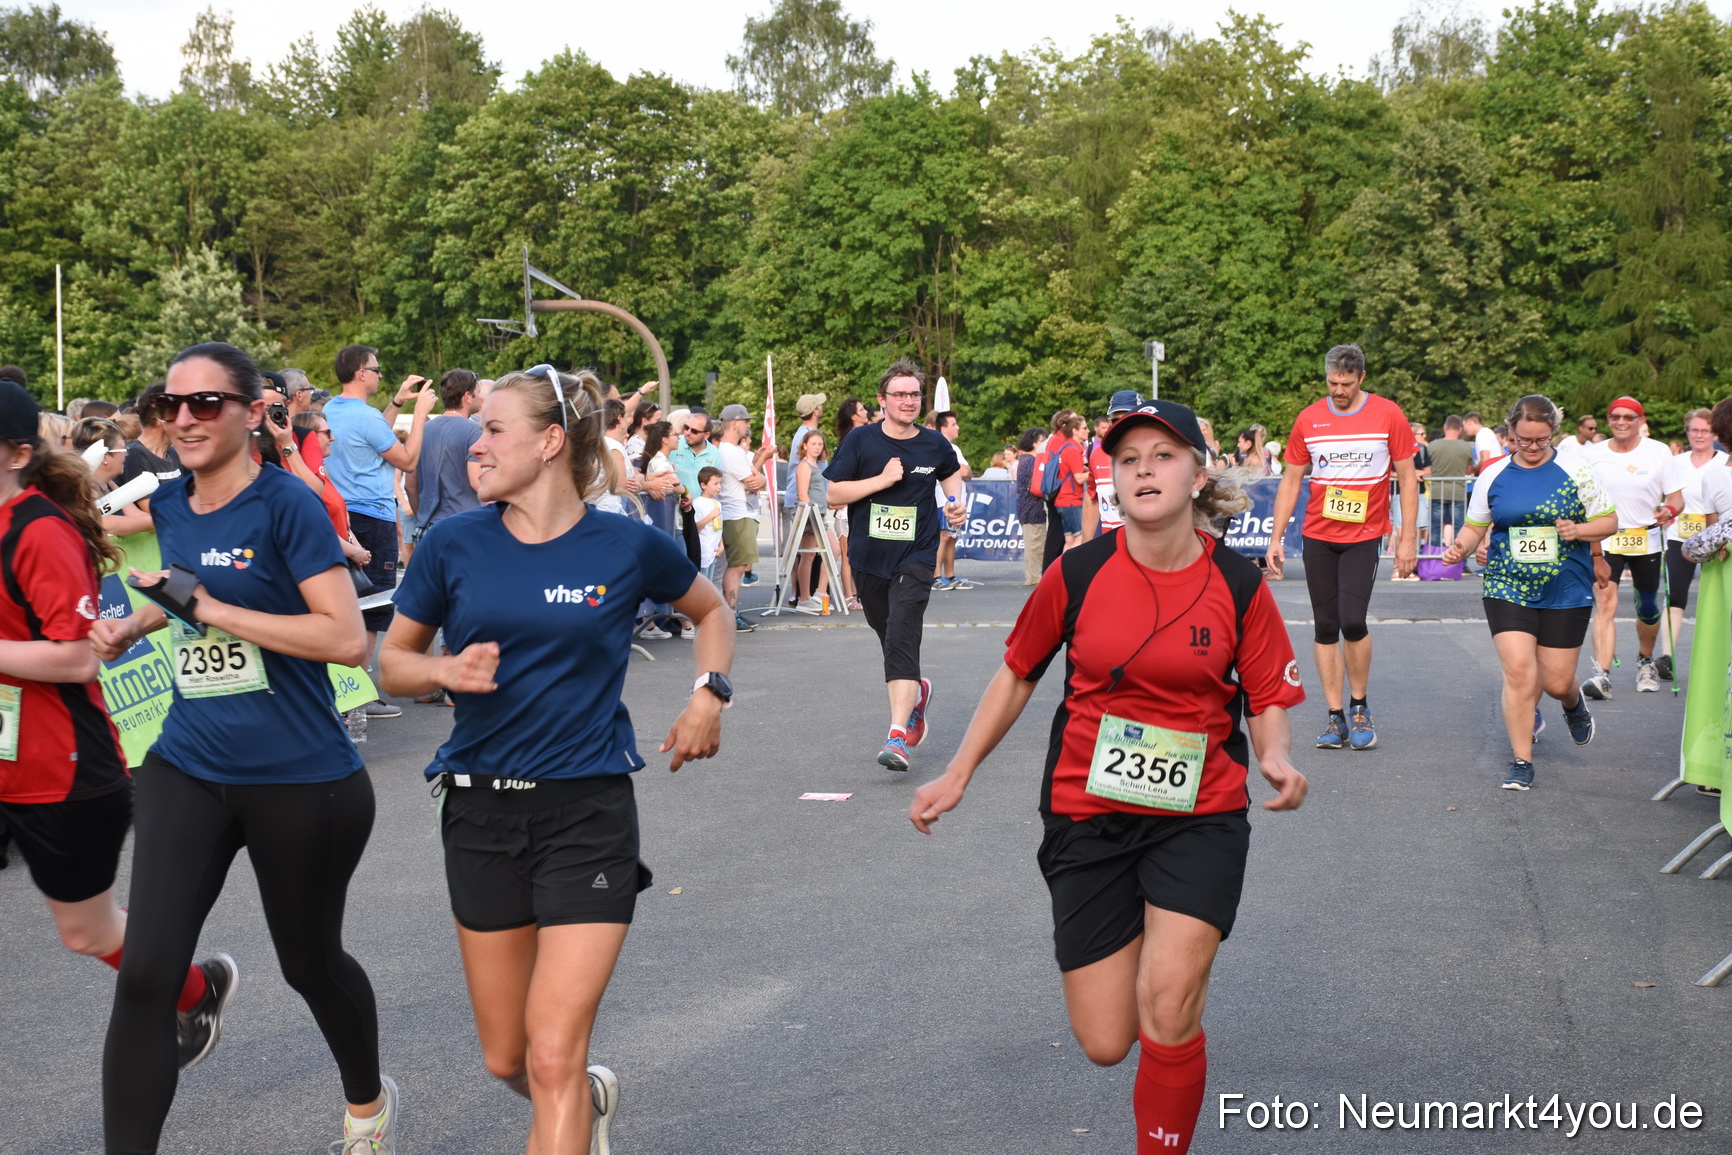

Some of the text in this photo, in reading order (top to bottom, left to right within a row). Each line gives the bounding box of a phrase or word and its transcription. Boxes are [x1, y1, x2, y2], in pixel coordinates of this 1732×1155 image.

[1329, 498, 1362, 514] 1812
[876, 516, 910, 531] 1405
[1683, 521, 1702, 532] 366
[955, 538, 1025, 549] AUTOMOB
[1519, 539, 1547, 553] 264
[1615, 536, 1643, 547] 1338
[201, 547, 232, 567] vhs
[544, 584, 585, 604] vhs
[1189, 625, 1212, 648] 18
[179, 642, 247, 676] 2395
[116, 699, 168, 735] neumarkt
[1104, 747, 1189, 787] 2356
[1147, 784, 1168, 795] Lena
